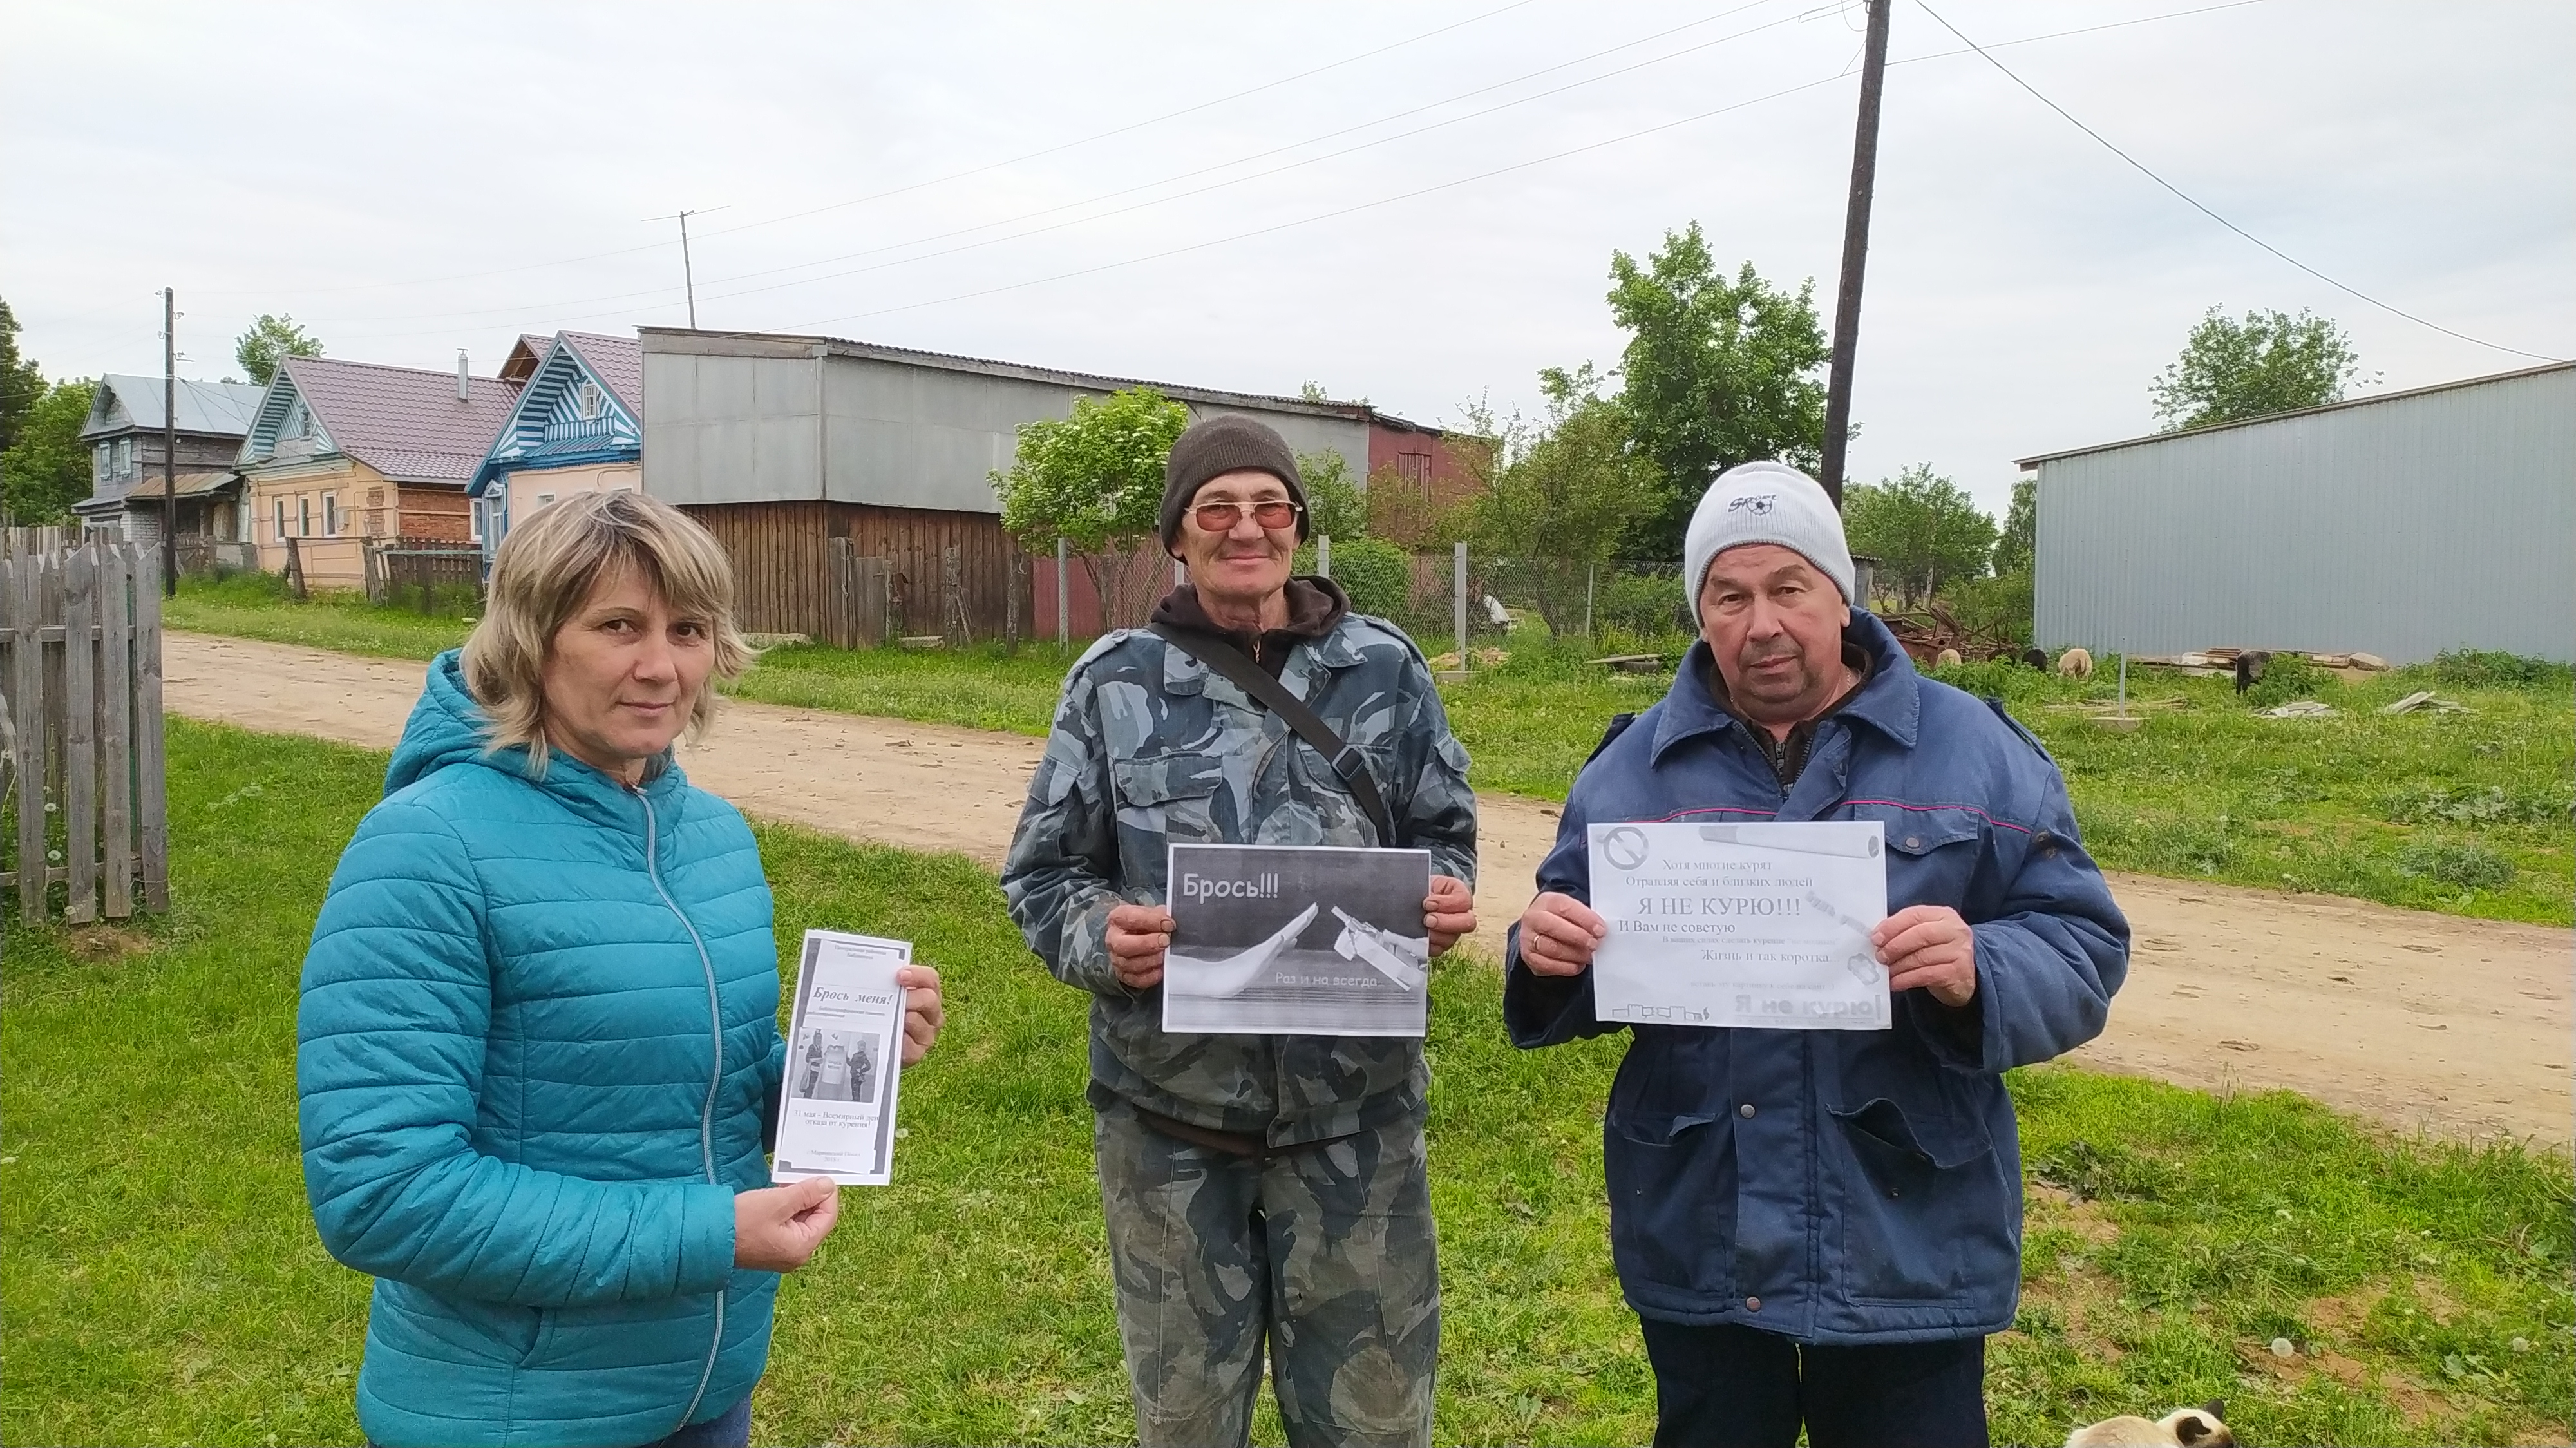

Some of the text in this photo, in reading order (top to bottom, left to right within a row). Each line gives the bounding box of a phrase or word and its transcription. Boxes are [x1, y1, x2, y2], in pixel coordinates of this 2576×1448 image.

[1663, 859, 1690, 871] Хотя
[1693, 861, 1736, 871] многие
[1183, 872, 1279, 904] Брось!!!
[1625, 877, 1814, 890] Отравляя себя и близких людей
[1637, 897, 1801, 916] Я НЕ КУРЮ!!!
[1619, 920, 1736, 935] И Вам не советую
[1701, 949, 1742, 961] Жизнь
[1757, 953, 1777, 962] так
[1276, 972, 1296, 984] Раз
[1300, 974, 1309, 985] и
[1313, 975, 1329, 986] на
[813, 987, 893, 1005] Брось меня!
[1735, 994, 1751, 1013] Я
[1761, 1000, 1793, 1015] не
[823, 1112, 865, 1121] Всемирный
[838, 1121, 871, 1129] курения!
